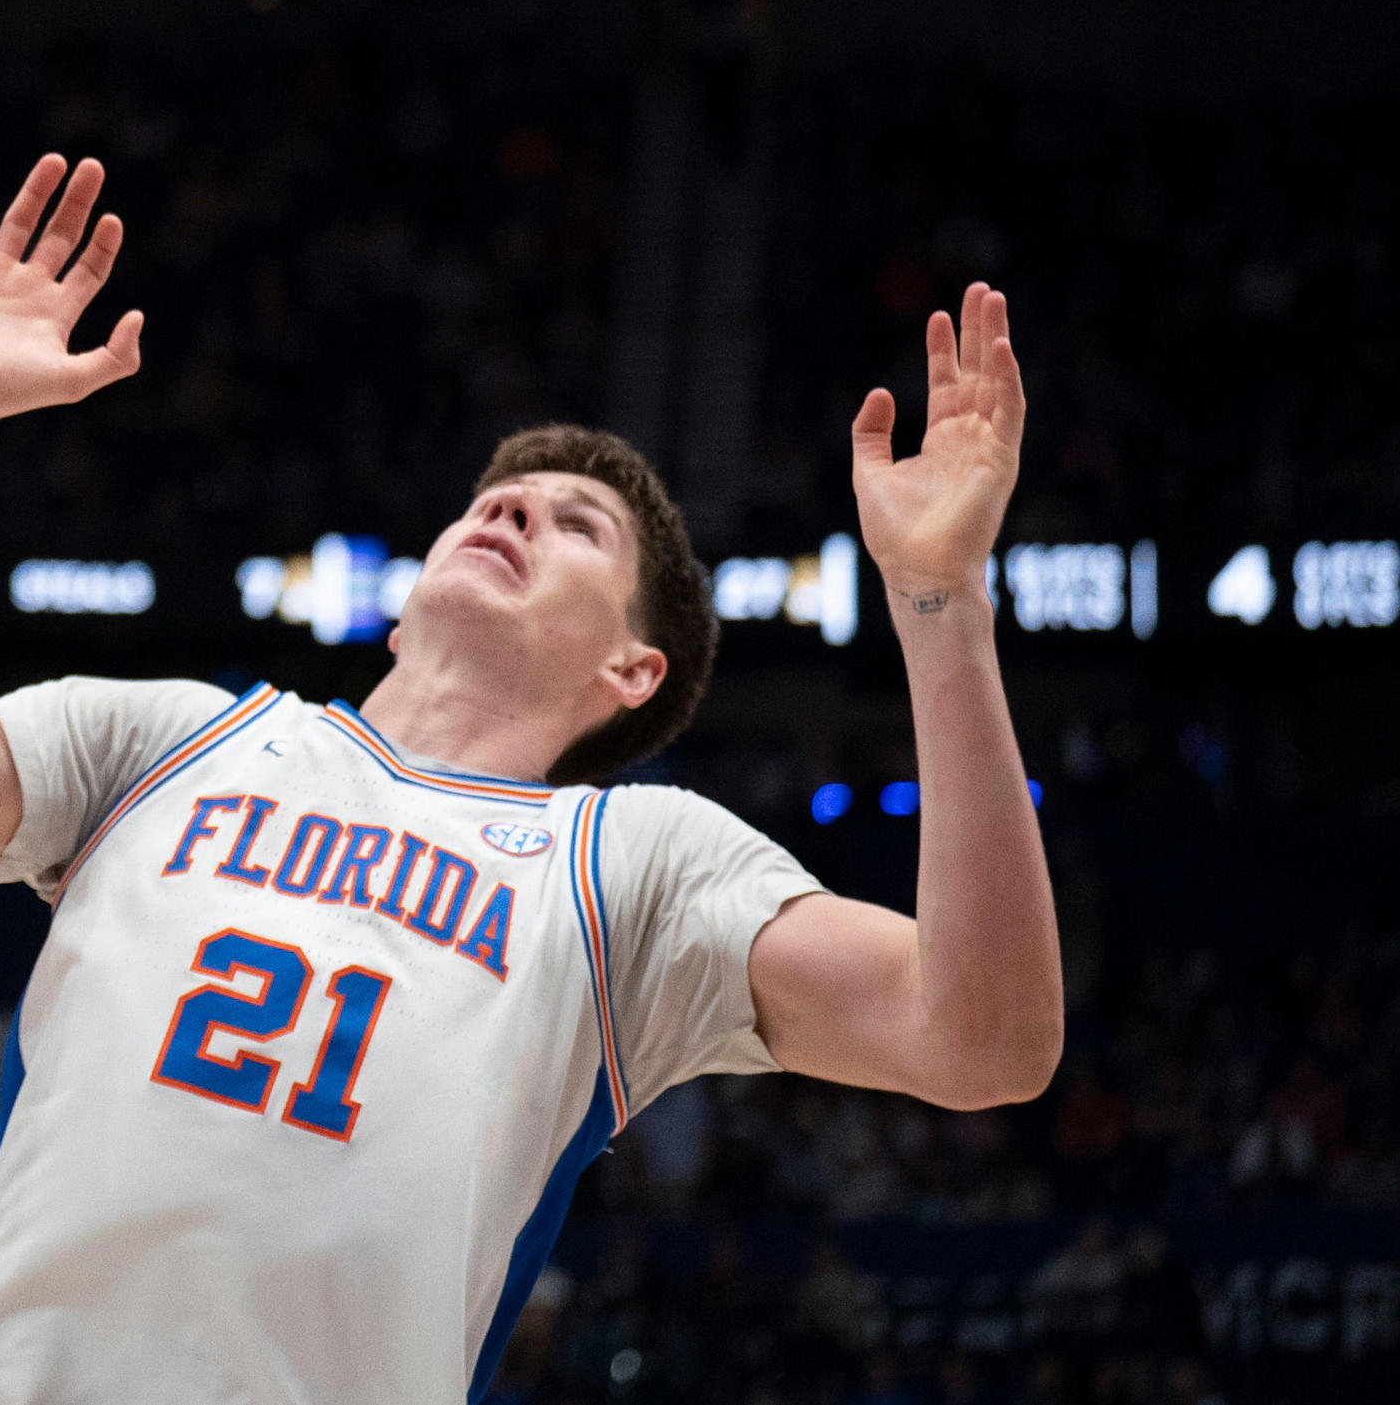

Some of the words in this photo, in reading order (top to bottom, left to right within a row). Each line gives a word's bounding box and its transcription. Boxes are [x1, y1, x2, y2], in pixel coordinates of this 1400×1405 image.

[162, 793, 516, 982] FLORIDA
[483, 823, 551, 856] SEC
[150, 927, 393, 1144] 21
